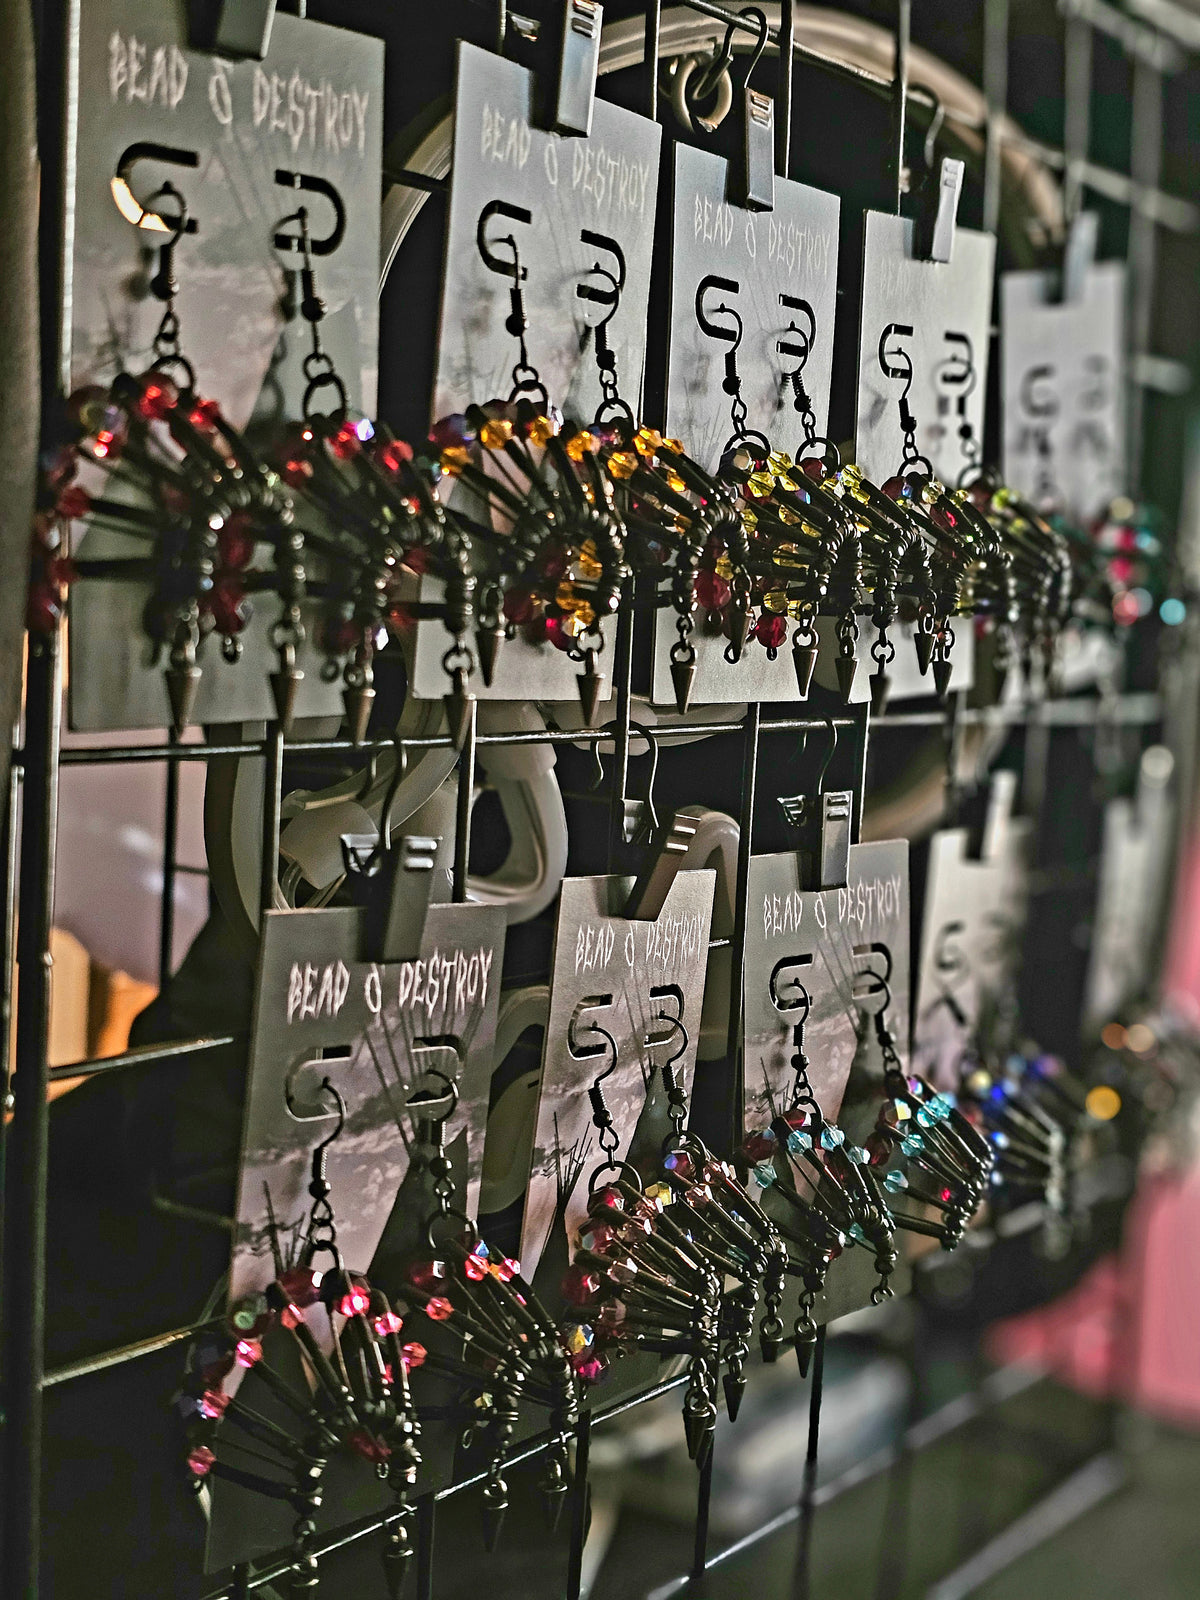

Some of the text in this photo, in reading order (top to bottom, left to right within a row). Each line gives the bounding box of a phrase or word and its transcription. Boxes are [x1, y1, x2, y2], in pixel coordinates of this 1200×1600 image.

[108, 29, 189, 110] BEAD
[252, 66, 370, 158] DESTROY
[481, 102, 532, 171] BEAD
[572, 138, 650, 222] DESTROY
[694, 192, 735, 248] BEAD
[768, 214, 832, 279] DESTROY
[575, 922, 616, 976] BEAD
[645, 911, 706, 971] DESTROY
[763, 889, 803, 940] BEAD
[838, 874, 901, 931] DESTROY
[287, 958, 350, 1025] BEAD
[399, 946, 493, 1019] DESTROY
